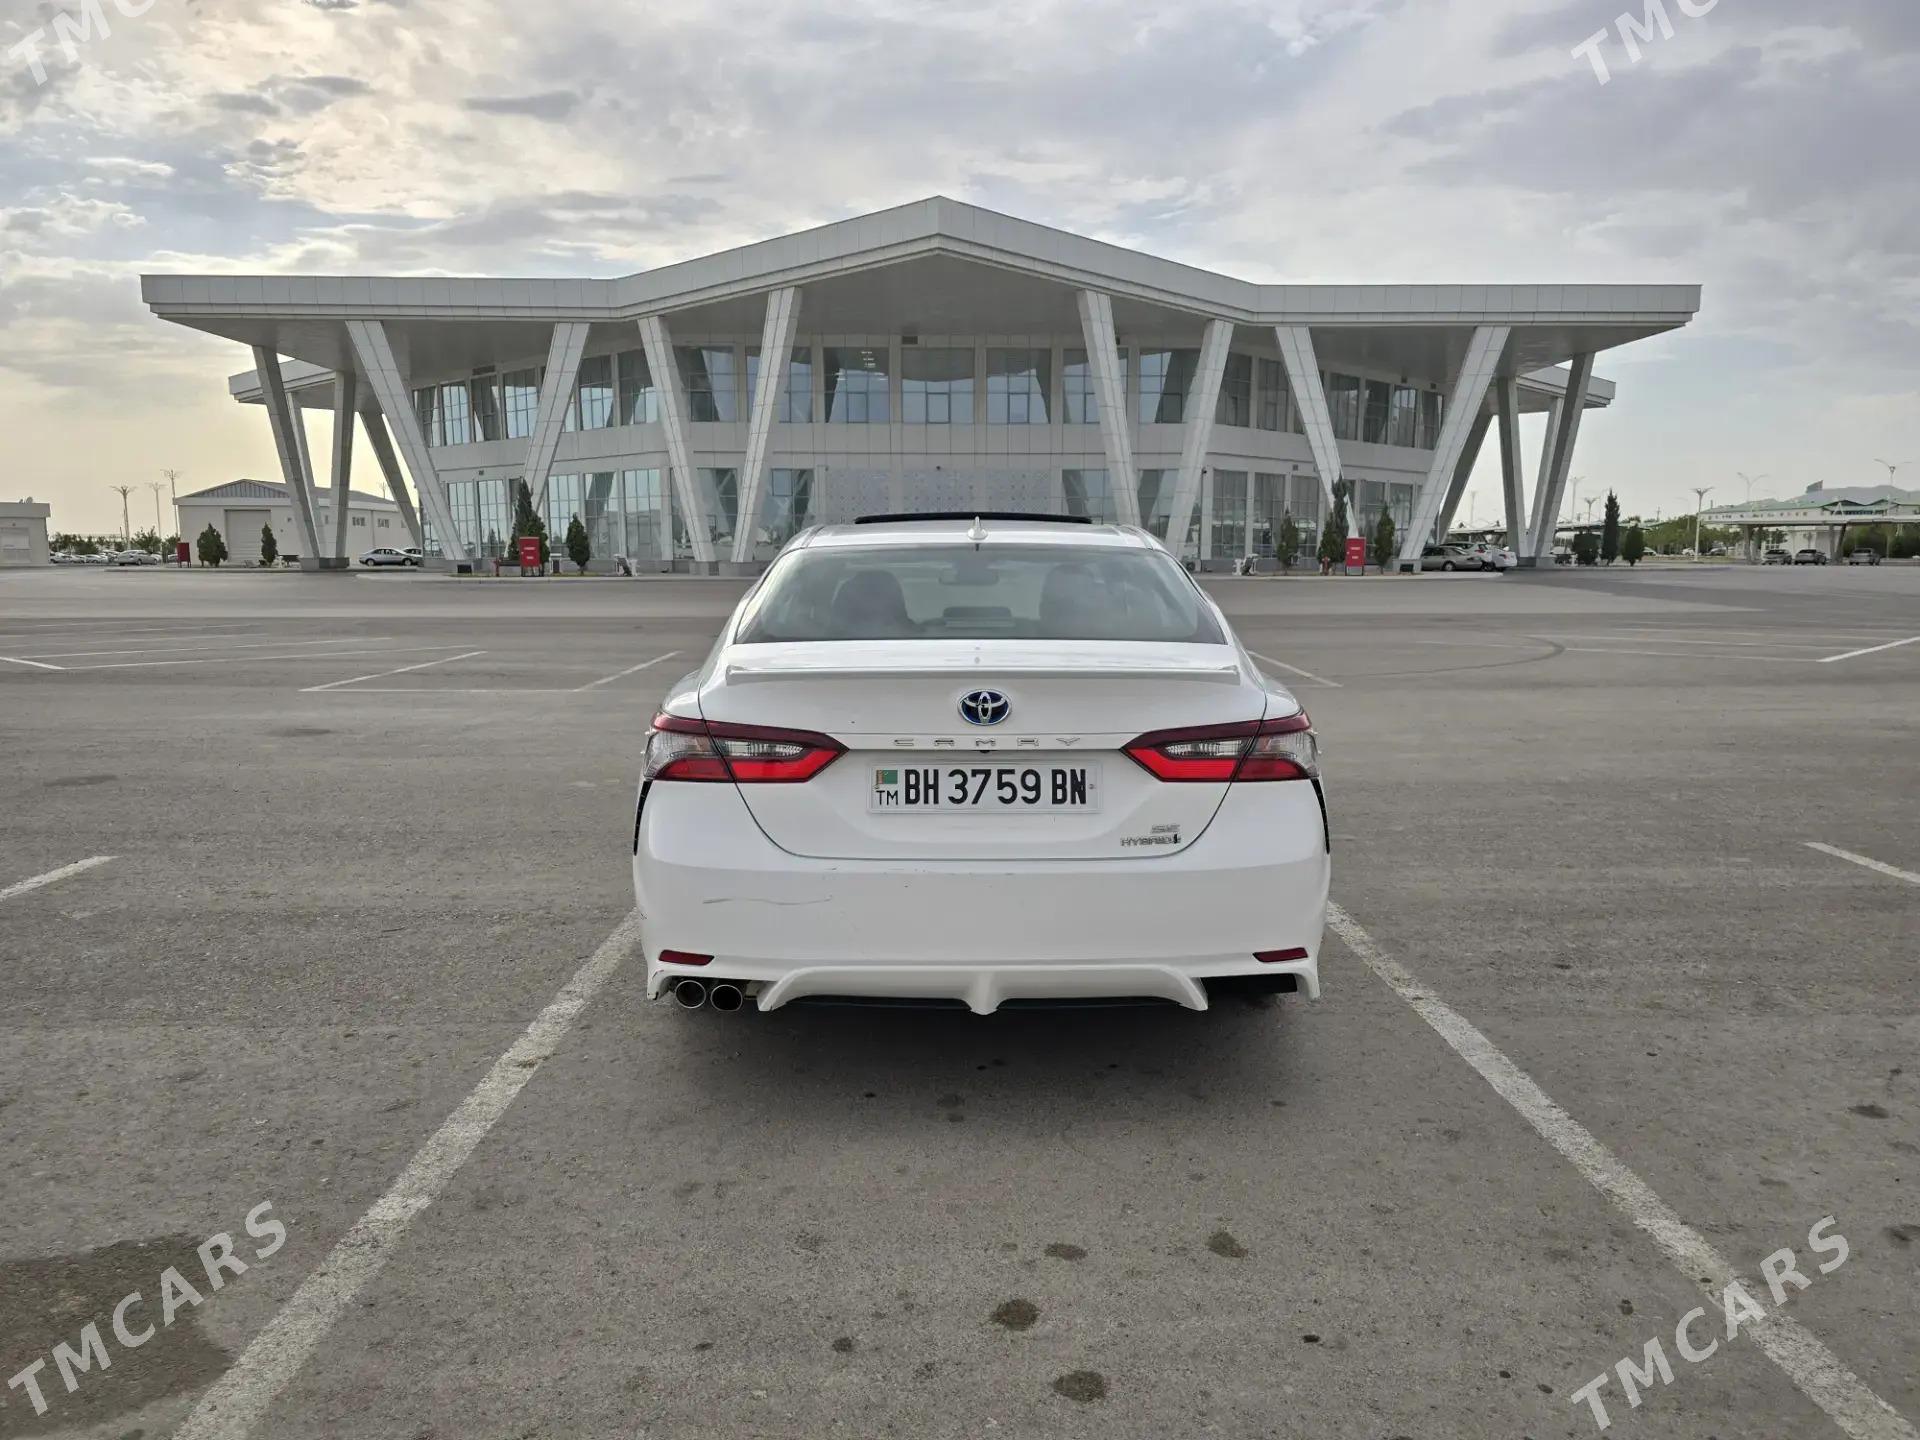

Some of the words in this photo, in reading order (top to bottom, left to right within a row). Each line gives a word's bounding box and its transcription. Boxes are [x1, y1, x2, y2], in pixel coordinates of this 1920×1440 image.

[894, 737, 1081, 747] CAMRY
[904, 769, 940, 805] BH
[947, 769, 1041, 805] 3759
[1051, 769, 1087, 805] BN
[876, 790, 898, 806] TM
